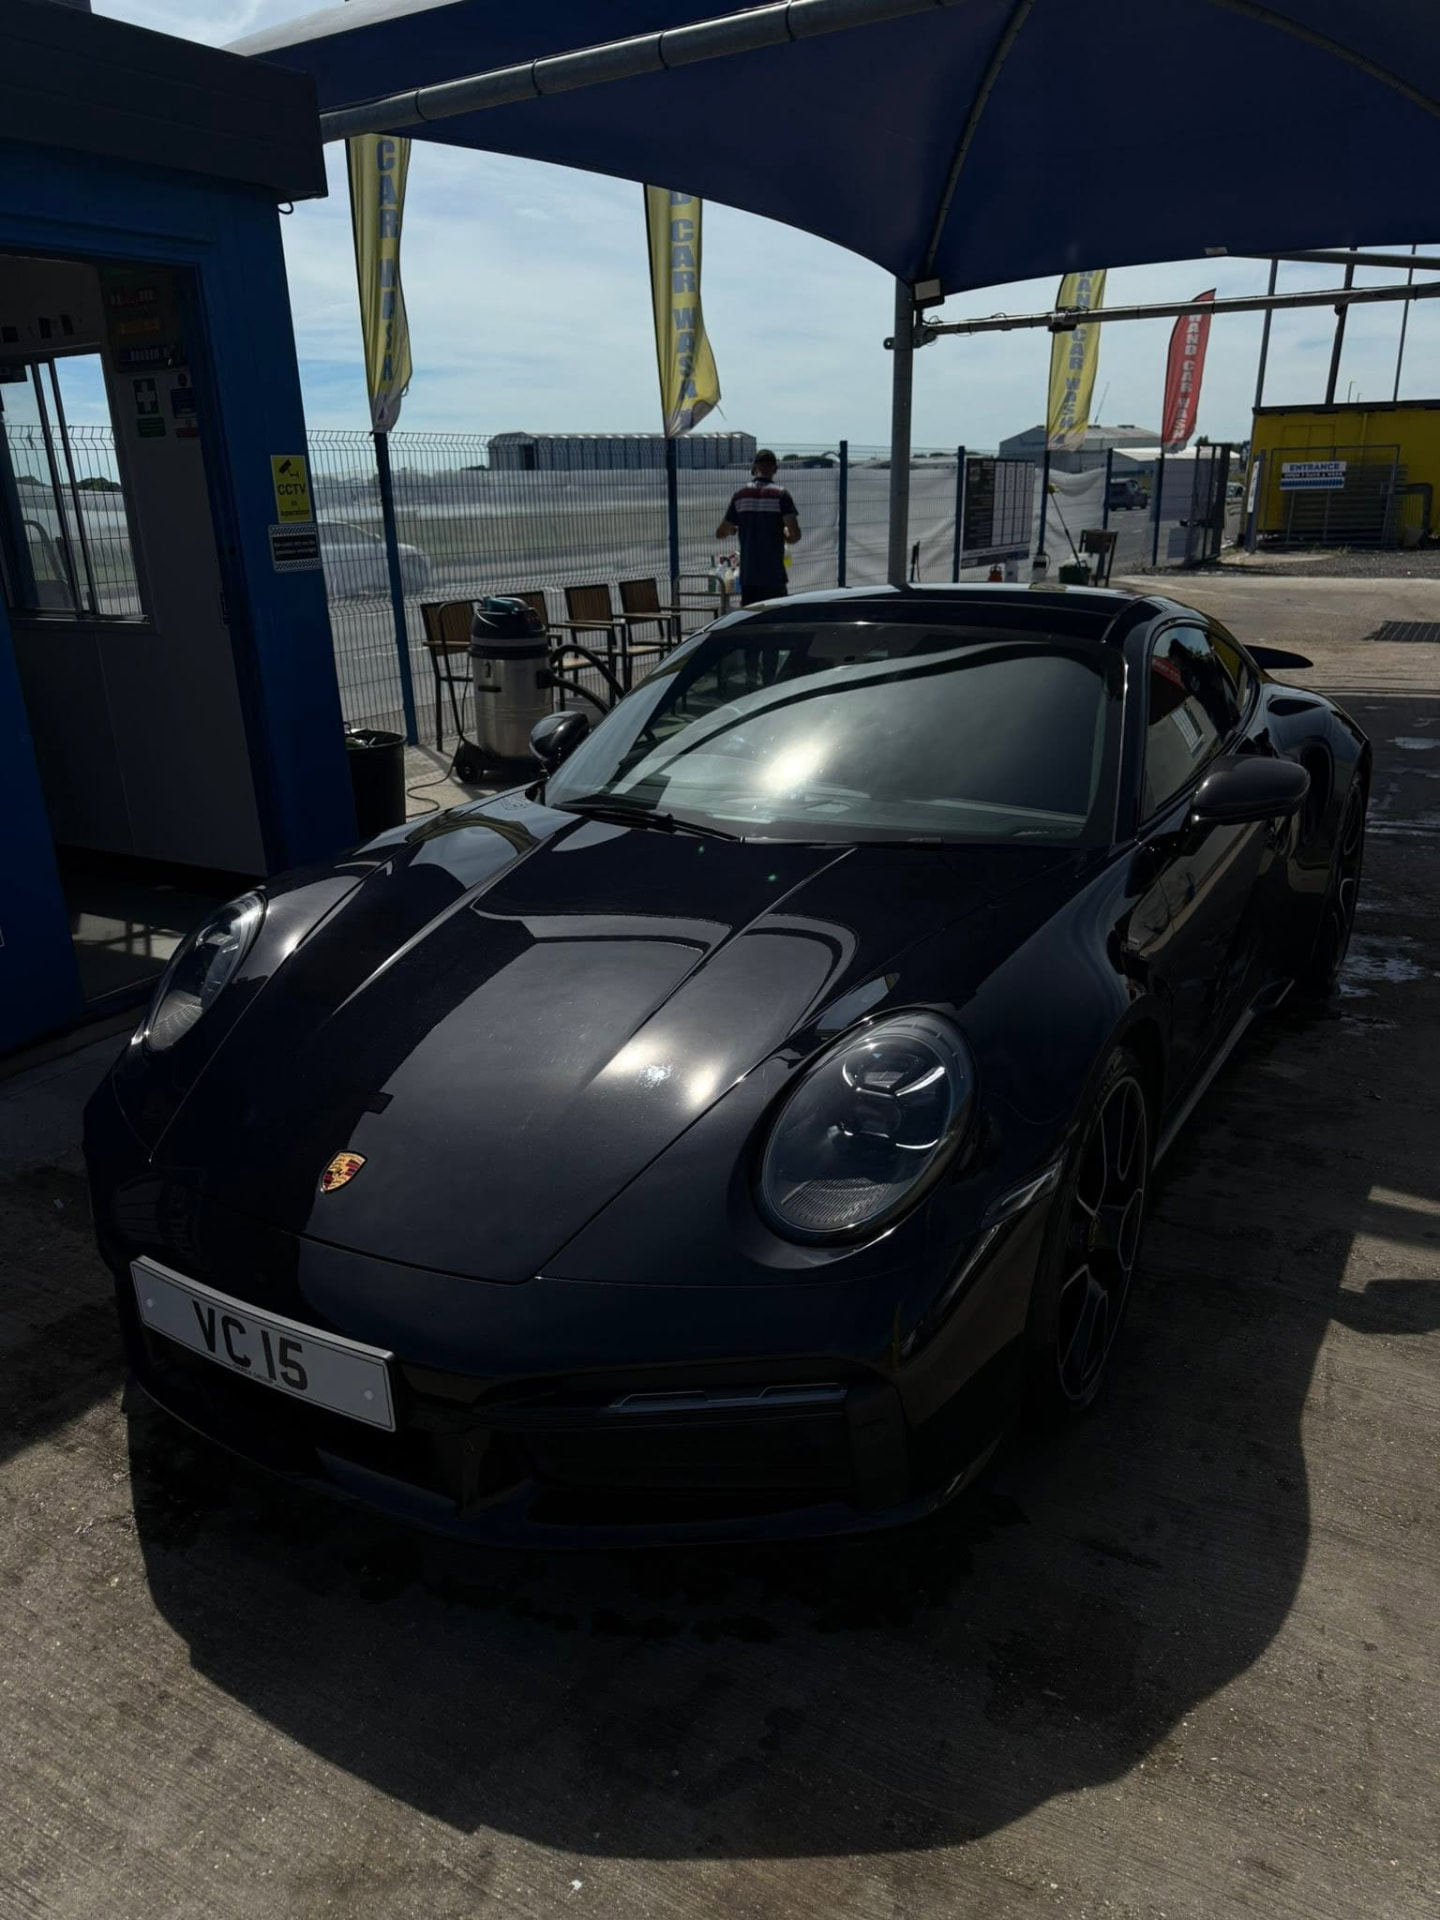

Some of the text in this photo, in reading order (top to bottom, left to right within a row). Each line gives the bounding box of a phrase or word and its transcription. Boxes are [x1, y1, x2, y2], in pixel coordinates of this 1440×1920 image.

[377, 139, 398, 239] CAR
[670, 218, 696, 294] CAR
[1069, 328, 1087, 370] CAR
[1180, 360, 1195, 393] CAR
[1290, 463, 1339, 471] ENTRANCE
[278, 483, 306, 495] CCTV
[192, 1299, 308, 1391] VC 15
